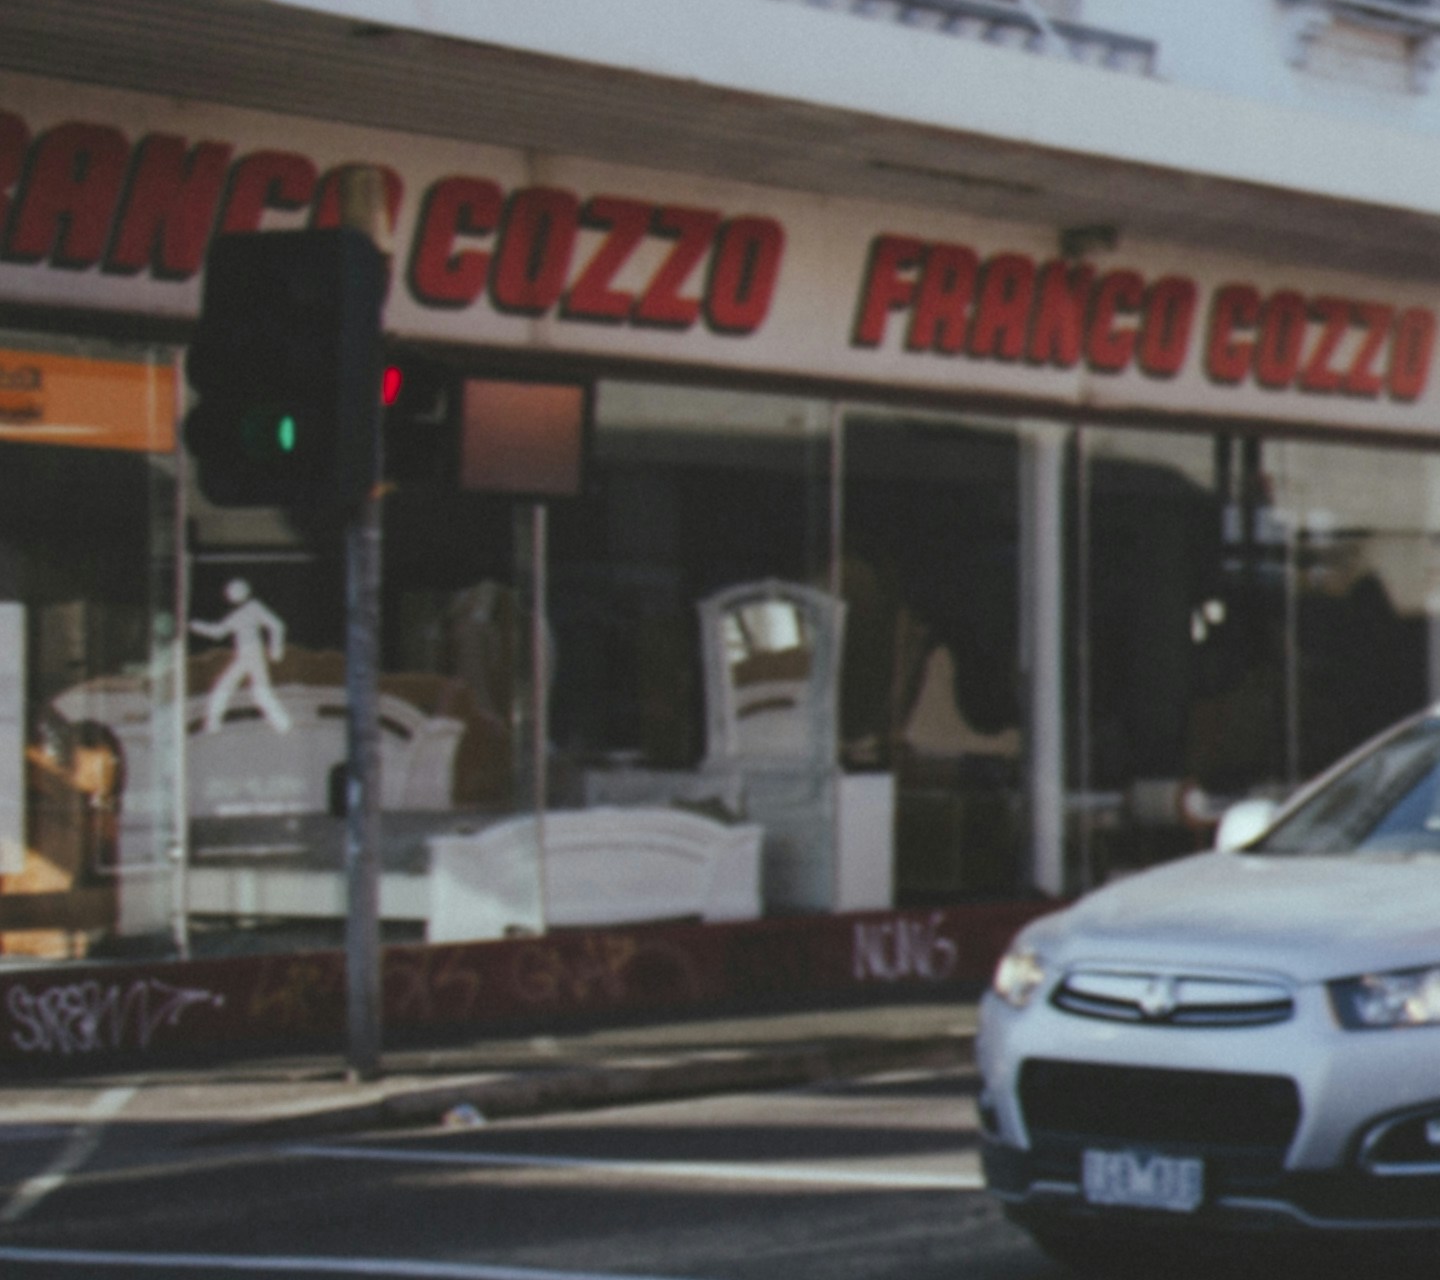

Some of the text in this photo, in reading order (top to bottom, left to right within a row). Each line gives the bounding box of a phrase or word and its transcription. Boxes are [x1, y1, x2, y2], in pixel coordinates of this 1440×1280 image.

[408, 176, 785, 334] COZZO
[853, 232, 1438, 403] FRANCO COZZO
